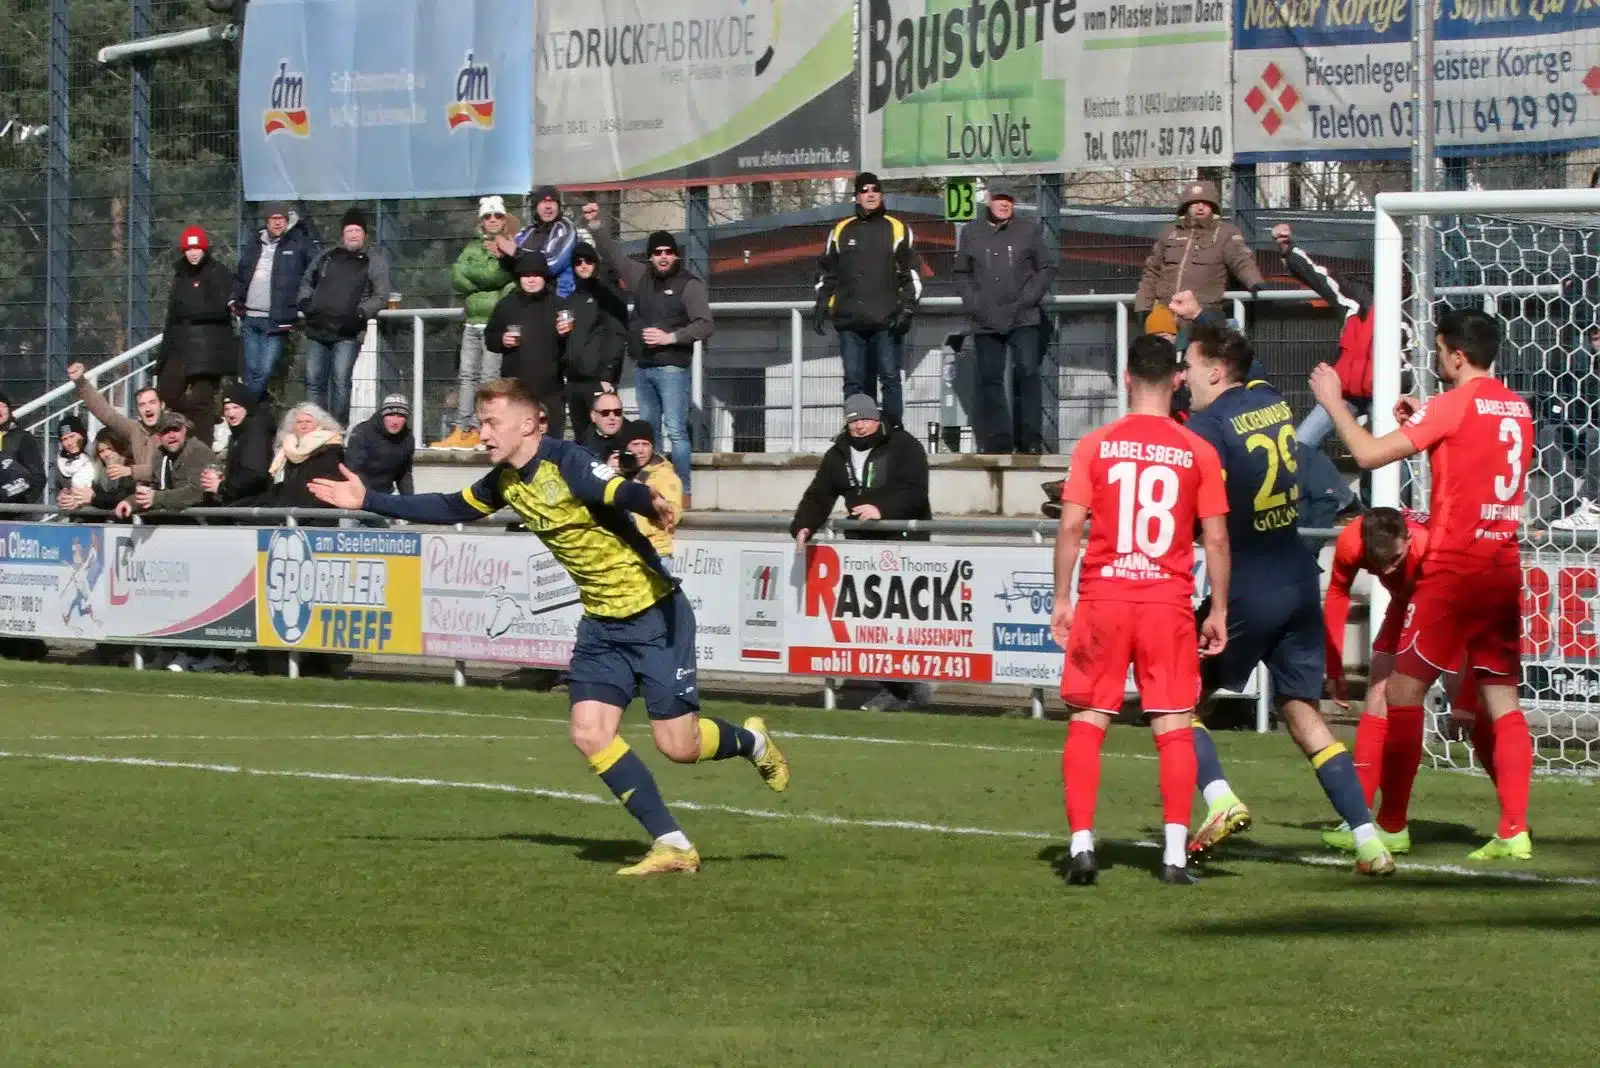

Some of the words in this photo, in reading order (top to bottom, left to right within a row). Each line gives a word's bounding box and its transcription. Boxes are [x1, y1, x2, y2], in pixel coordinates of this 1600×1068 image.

[1084, 10, 1105, 31] vom
[1110, 5, 1152, 29] Pflaster
[271, 62, 303, 109] dm
[456, 53, 489, 102] dm
[1308, 104, 1384, 139] Telefon
[1473, 97, 1501, 133] 64
[1507, 95, 1538, 131] 29
[1547, 92, 1577, 128] 99
[946, 112, 1032, 160] LouVet
[1084, 131, 1107, 161] Tel.
[1159, 127, 1174, 156] 59
[1178, 126, 1195, 155] 73
[1200, 125, 1223, 155] 40
[950, 182, 975, 219] D3
[1100, 441, 1193, 469] BABELSBERG
[1494, 417, 1523, 502] 3
[1107, 461, 1180, 558] 18
[8, 531, 40, 559] Clean
[315, 536, 334, 552] am
[337, 532, 417, 554] Seelenbinder
[844, 556, 878, 572] Frank
[879, 550, 899, 572] &
[900, 556, 949, 574] Thomas
[267, 559, 386, 606] SPORTLER
[805, 545, 962, 643] RASACK
[320, 608, 393, 650] TREFF
[1403, 603, 1416, 628] 3
[855, 624, 888, 645] INNEN
[906, 628, 973, 648] AUSSENPUTZ
[996, 627, 1044, 647] Verkauf
[810, 651, 851, 672] mobil
[858, 652, 920, 676] 0173-66
[995, 661, 1050, 680] Luckenwalde
